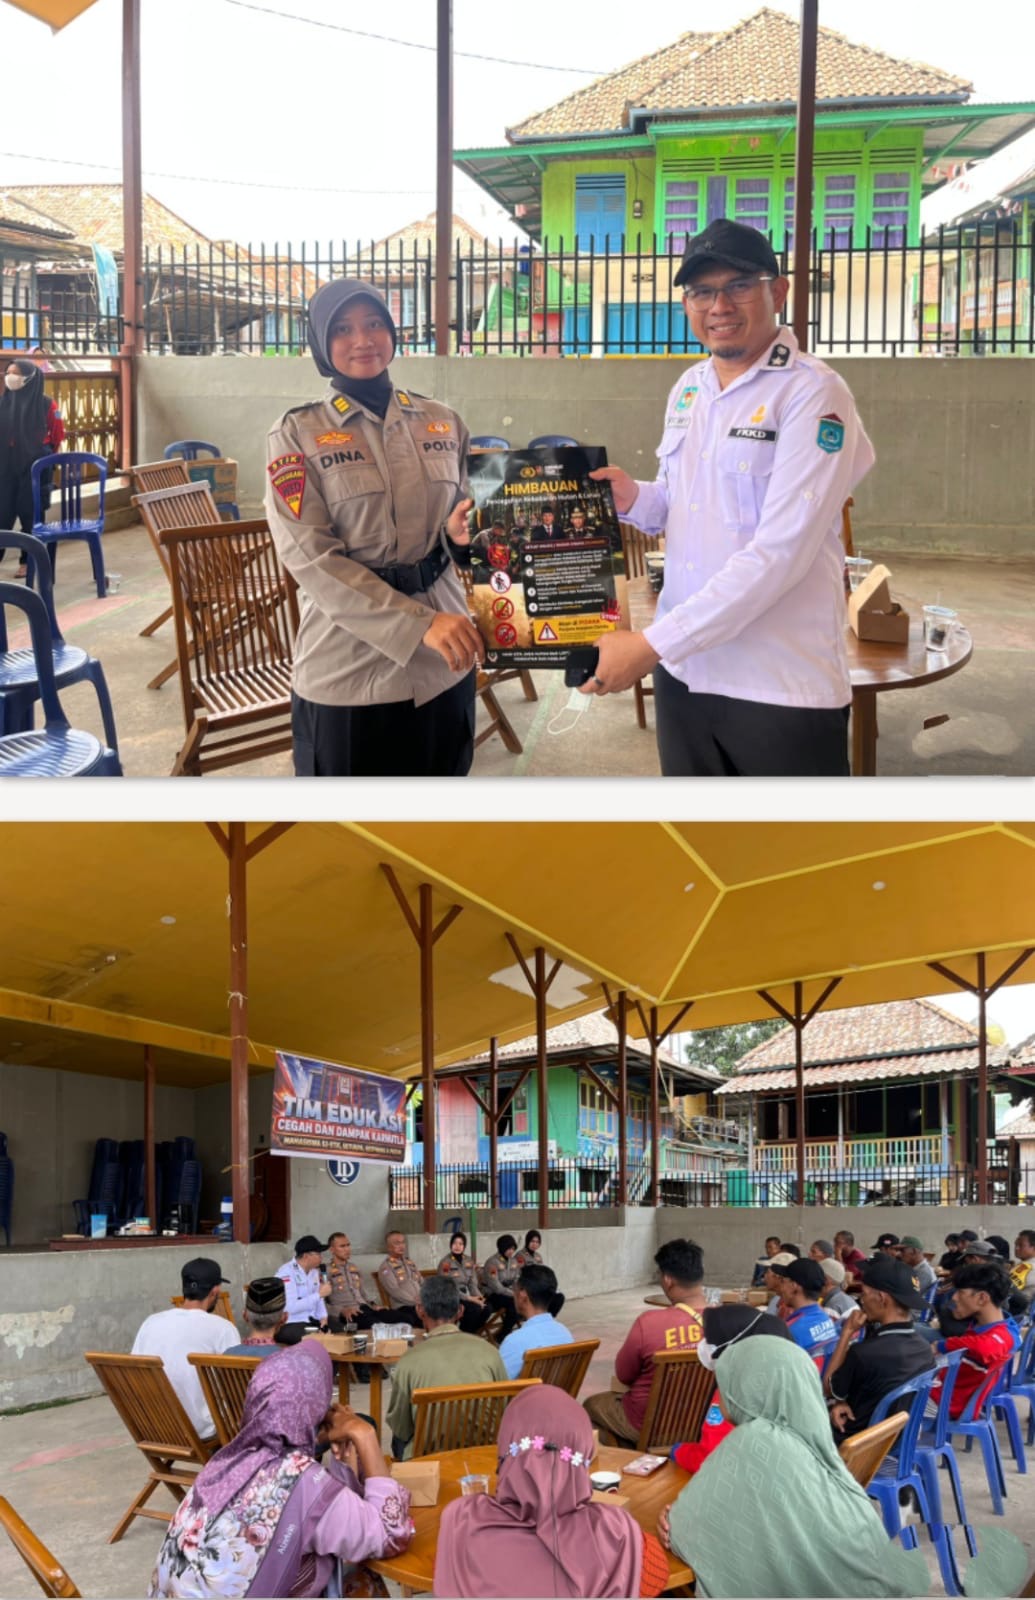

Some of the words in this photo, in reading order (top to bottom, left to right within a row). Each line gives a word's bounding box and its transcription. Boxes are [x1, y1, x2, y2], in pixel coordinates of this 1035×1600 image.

[320, 449, 365, 470] DINA
[503, 480, 578, 496] HIMBAUAN
[283, 1095, 322, 1122] TIM
[327, 1103, 403, 1133] EDUKASI
[277, 1119, 313, 1133] CEGAH
[314, 1123, 335, 1136] DAN
[336, 1126, 370, 1141] DAMPAK
[665, 1324, 701, 1349] EIG
